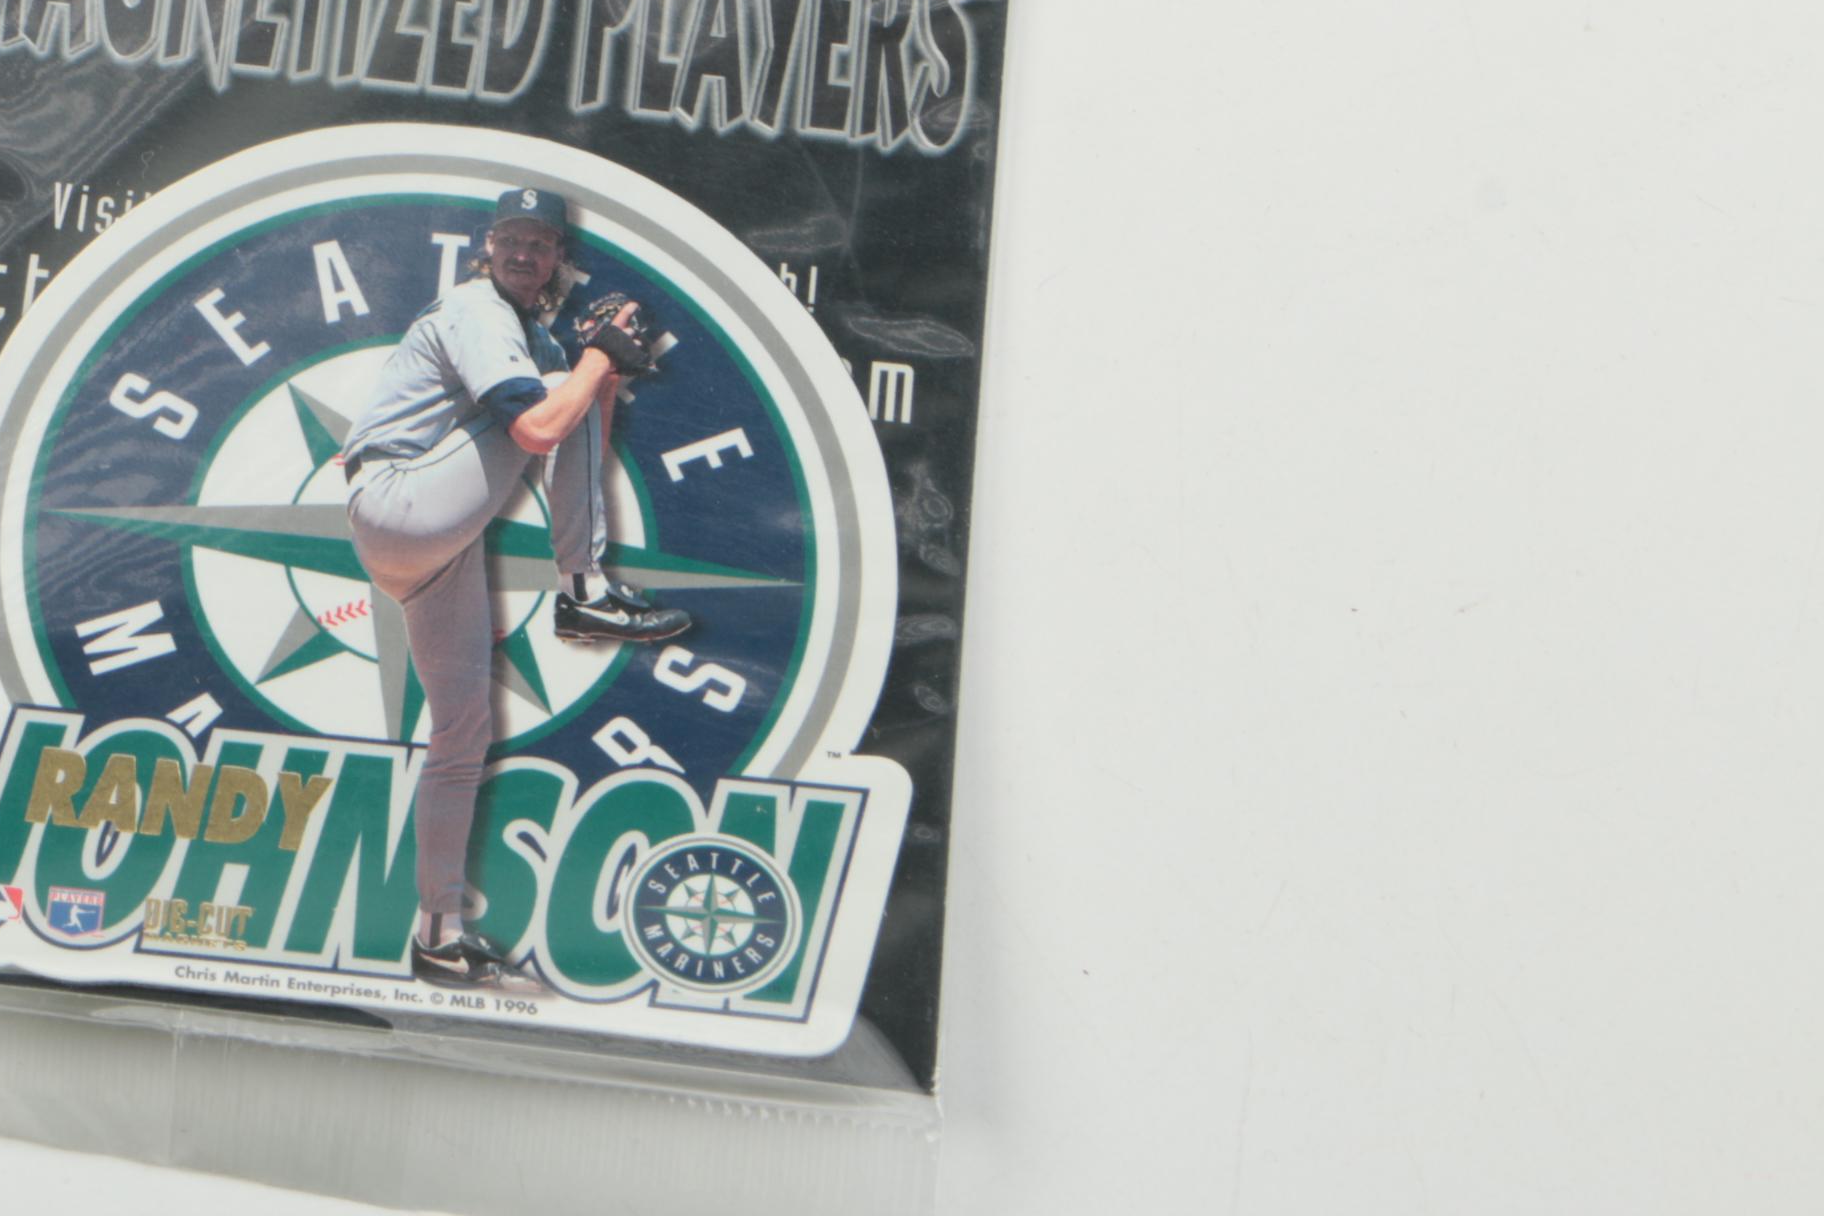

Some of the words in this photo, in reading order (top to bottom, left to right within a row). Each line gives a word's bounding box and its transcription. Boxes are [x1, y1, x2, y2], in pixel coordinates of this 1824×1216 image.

[24, 746, 334, 852] RANDY
[647, 852, 777, 905] SEATTLE
[643, 923, 776, 979] MARINERS
[174, 965, 217, 983] Chris
[224, 970, 281, 989] Martin
[287, 977, 387, 1001] Enterprises,
[394, 988, 424, 1004] Inc.
[449, 994, 487, 1011] MLB
[494, 997, 539, 1016] 1996
